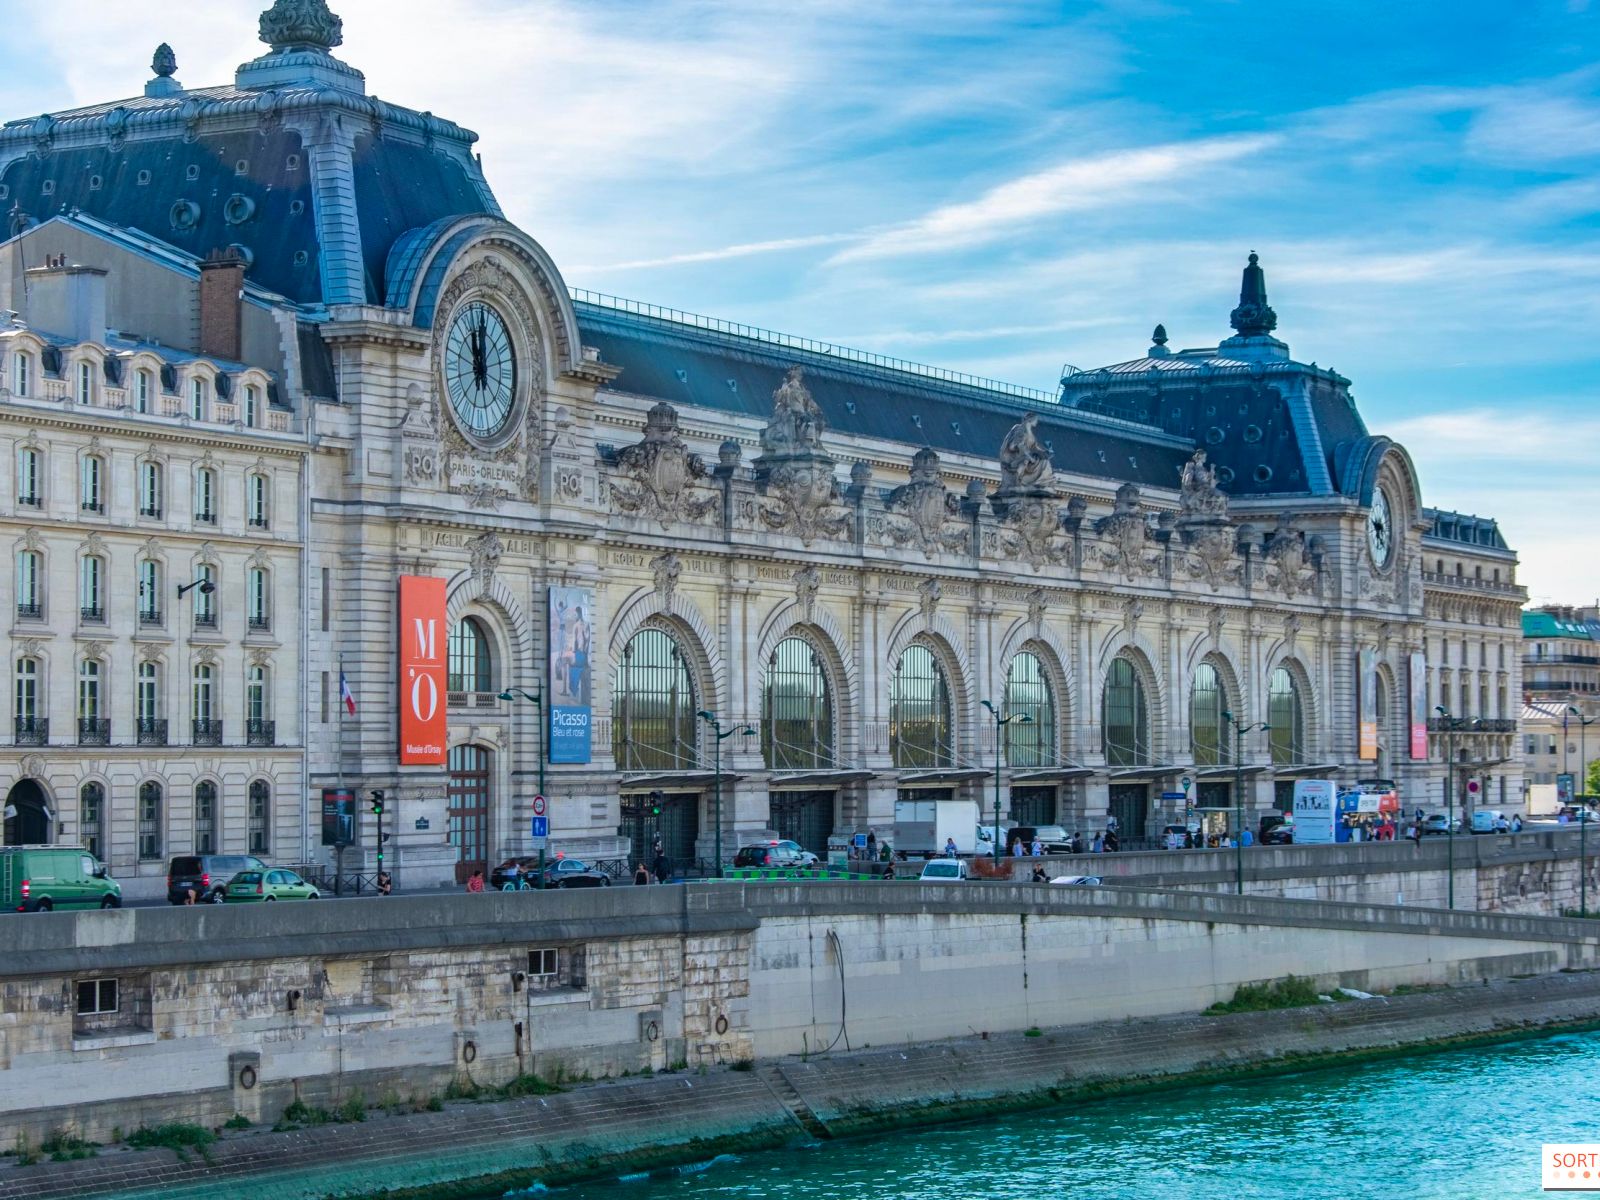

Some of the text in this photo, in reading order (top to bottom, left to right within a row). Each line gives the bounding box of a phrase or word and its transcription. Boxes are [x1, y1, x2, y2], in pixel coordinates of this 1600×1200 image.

[413, 618, 437, 660] M
[553, 708, 588, 726] Picasso
[553, 726, 585, 737] Bleu et rose
[406, 743, 441, 756] Musée d'Orsay
